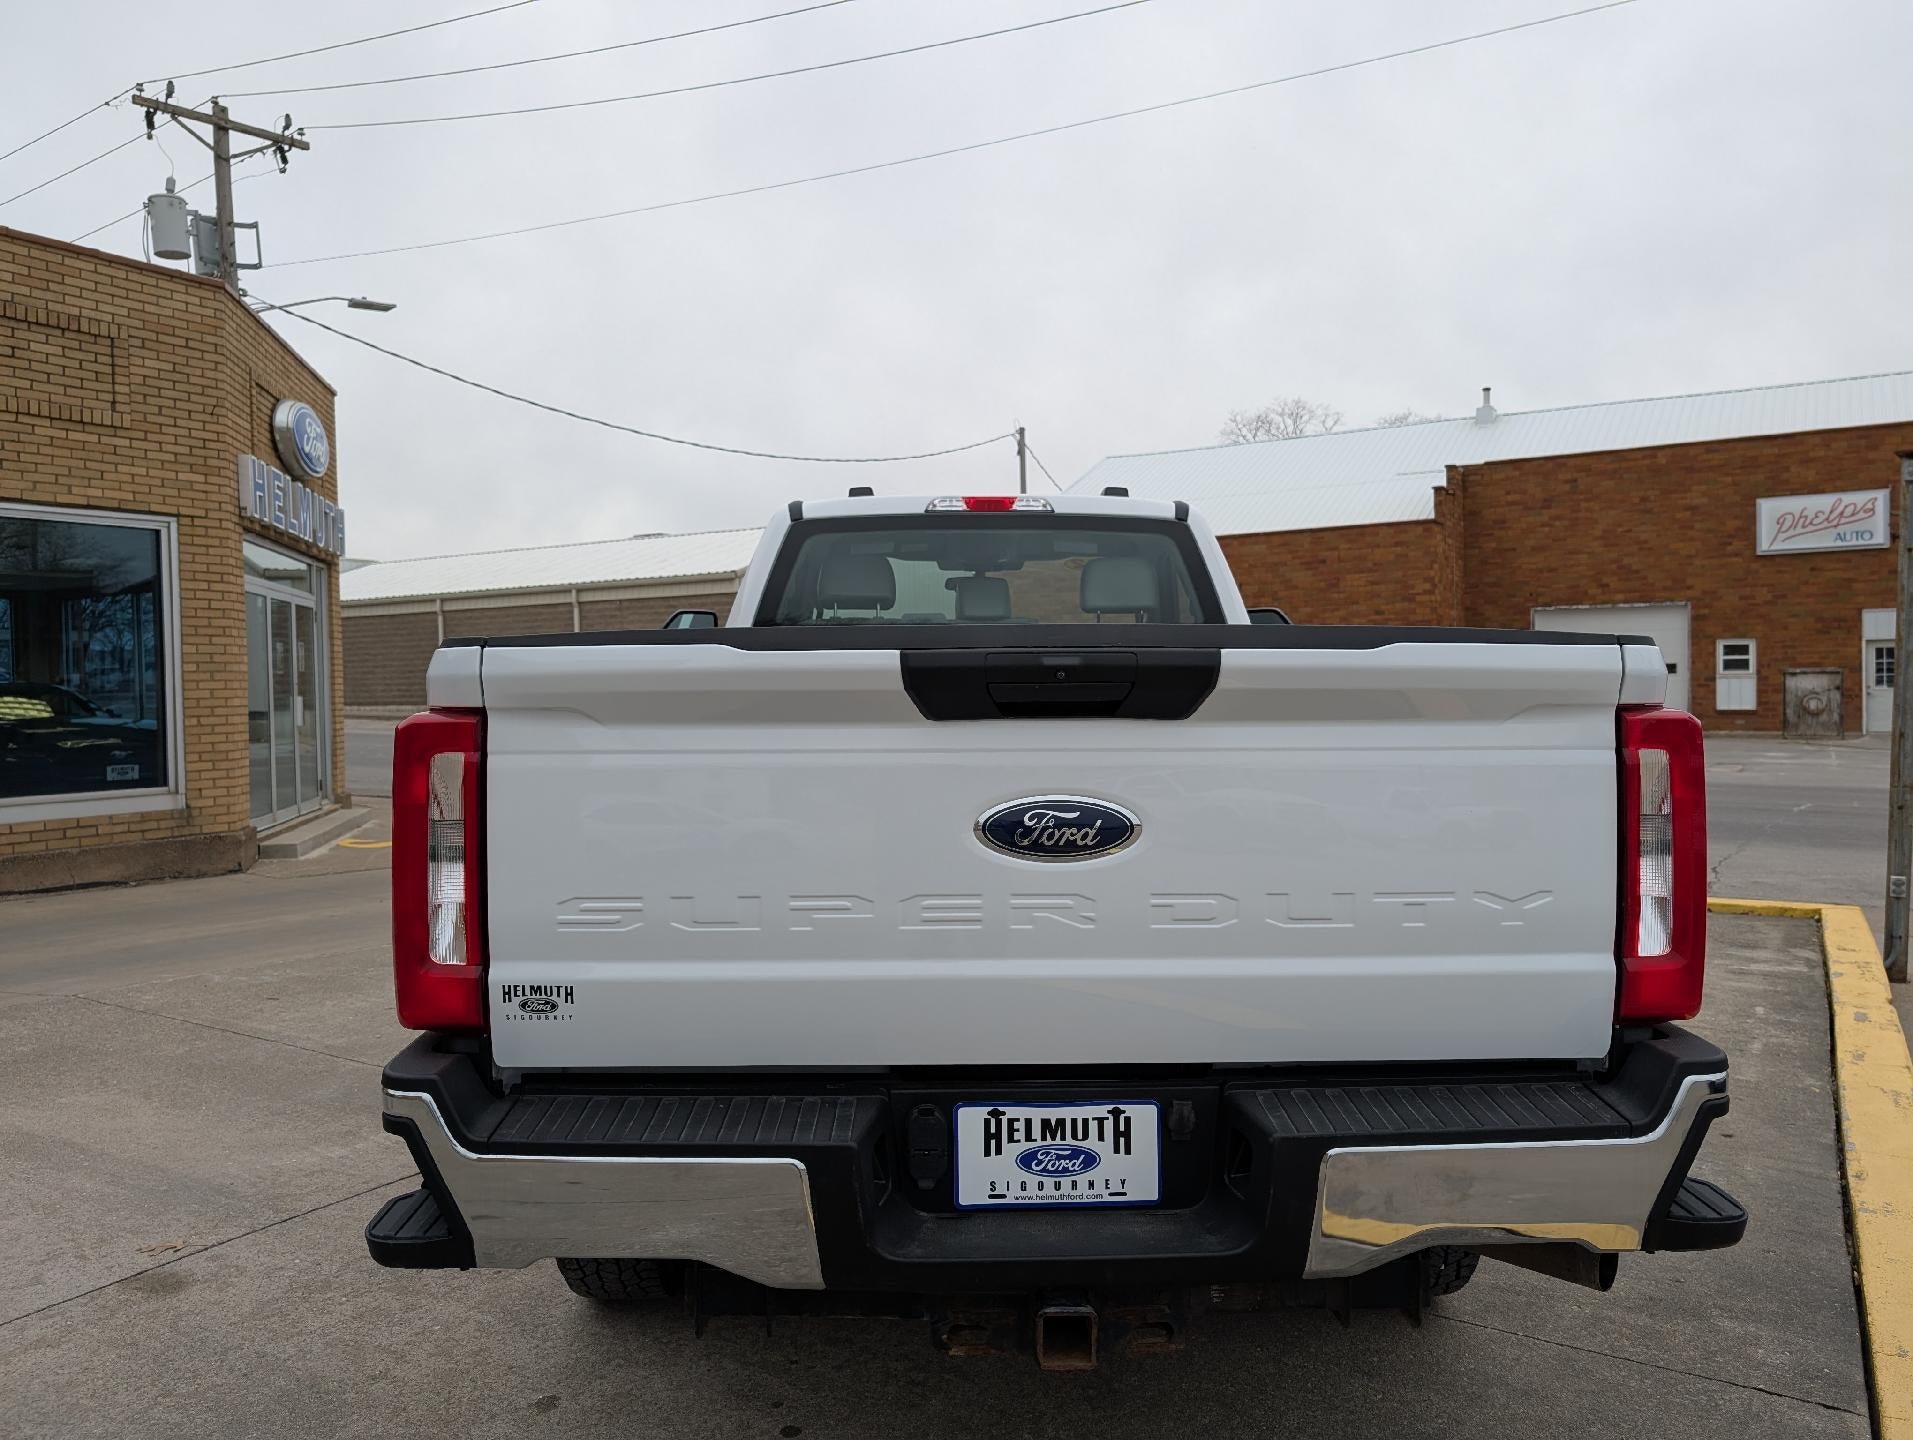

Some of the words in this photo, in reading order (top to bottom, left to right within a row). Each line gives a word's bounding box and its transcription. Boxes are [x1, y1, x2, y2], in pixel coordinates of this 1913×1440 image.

[303, 417, 325, 464] Ford
[250, 455, 345, 556] HELMUTH
[1767, 497, 1878, 549] Phelps
[1833, 530, 1874, 543] AUTO
[1014, 809, 1103, 846] Ford
[556, 892, 1096, 931] SUPER
[1150, 890, 1554, 929] DUTY
[502, 985, 574, 1004] HELMUTH
[525, 1000, 552, 1011] Ford
[983, 1107, 1132, 1157] HELMUTH
[1031, 1149, 1084, 1172] Ford
[989, 1178, 1127, 1192] SIGOURNEY
[1013, 1192, 1104, 1202] www.helmuthford.com
